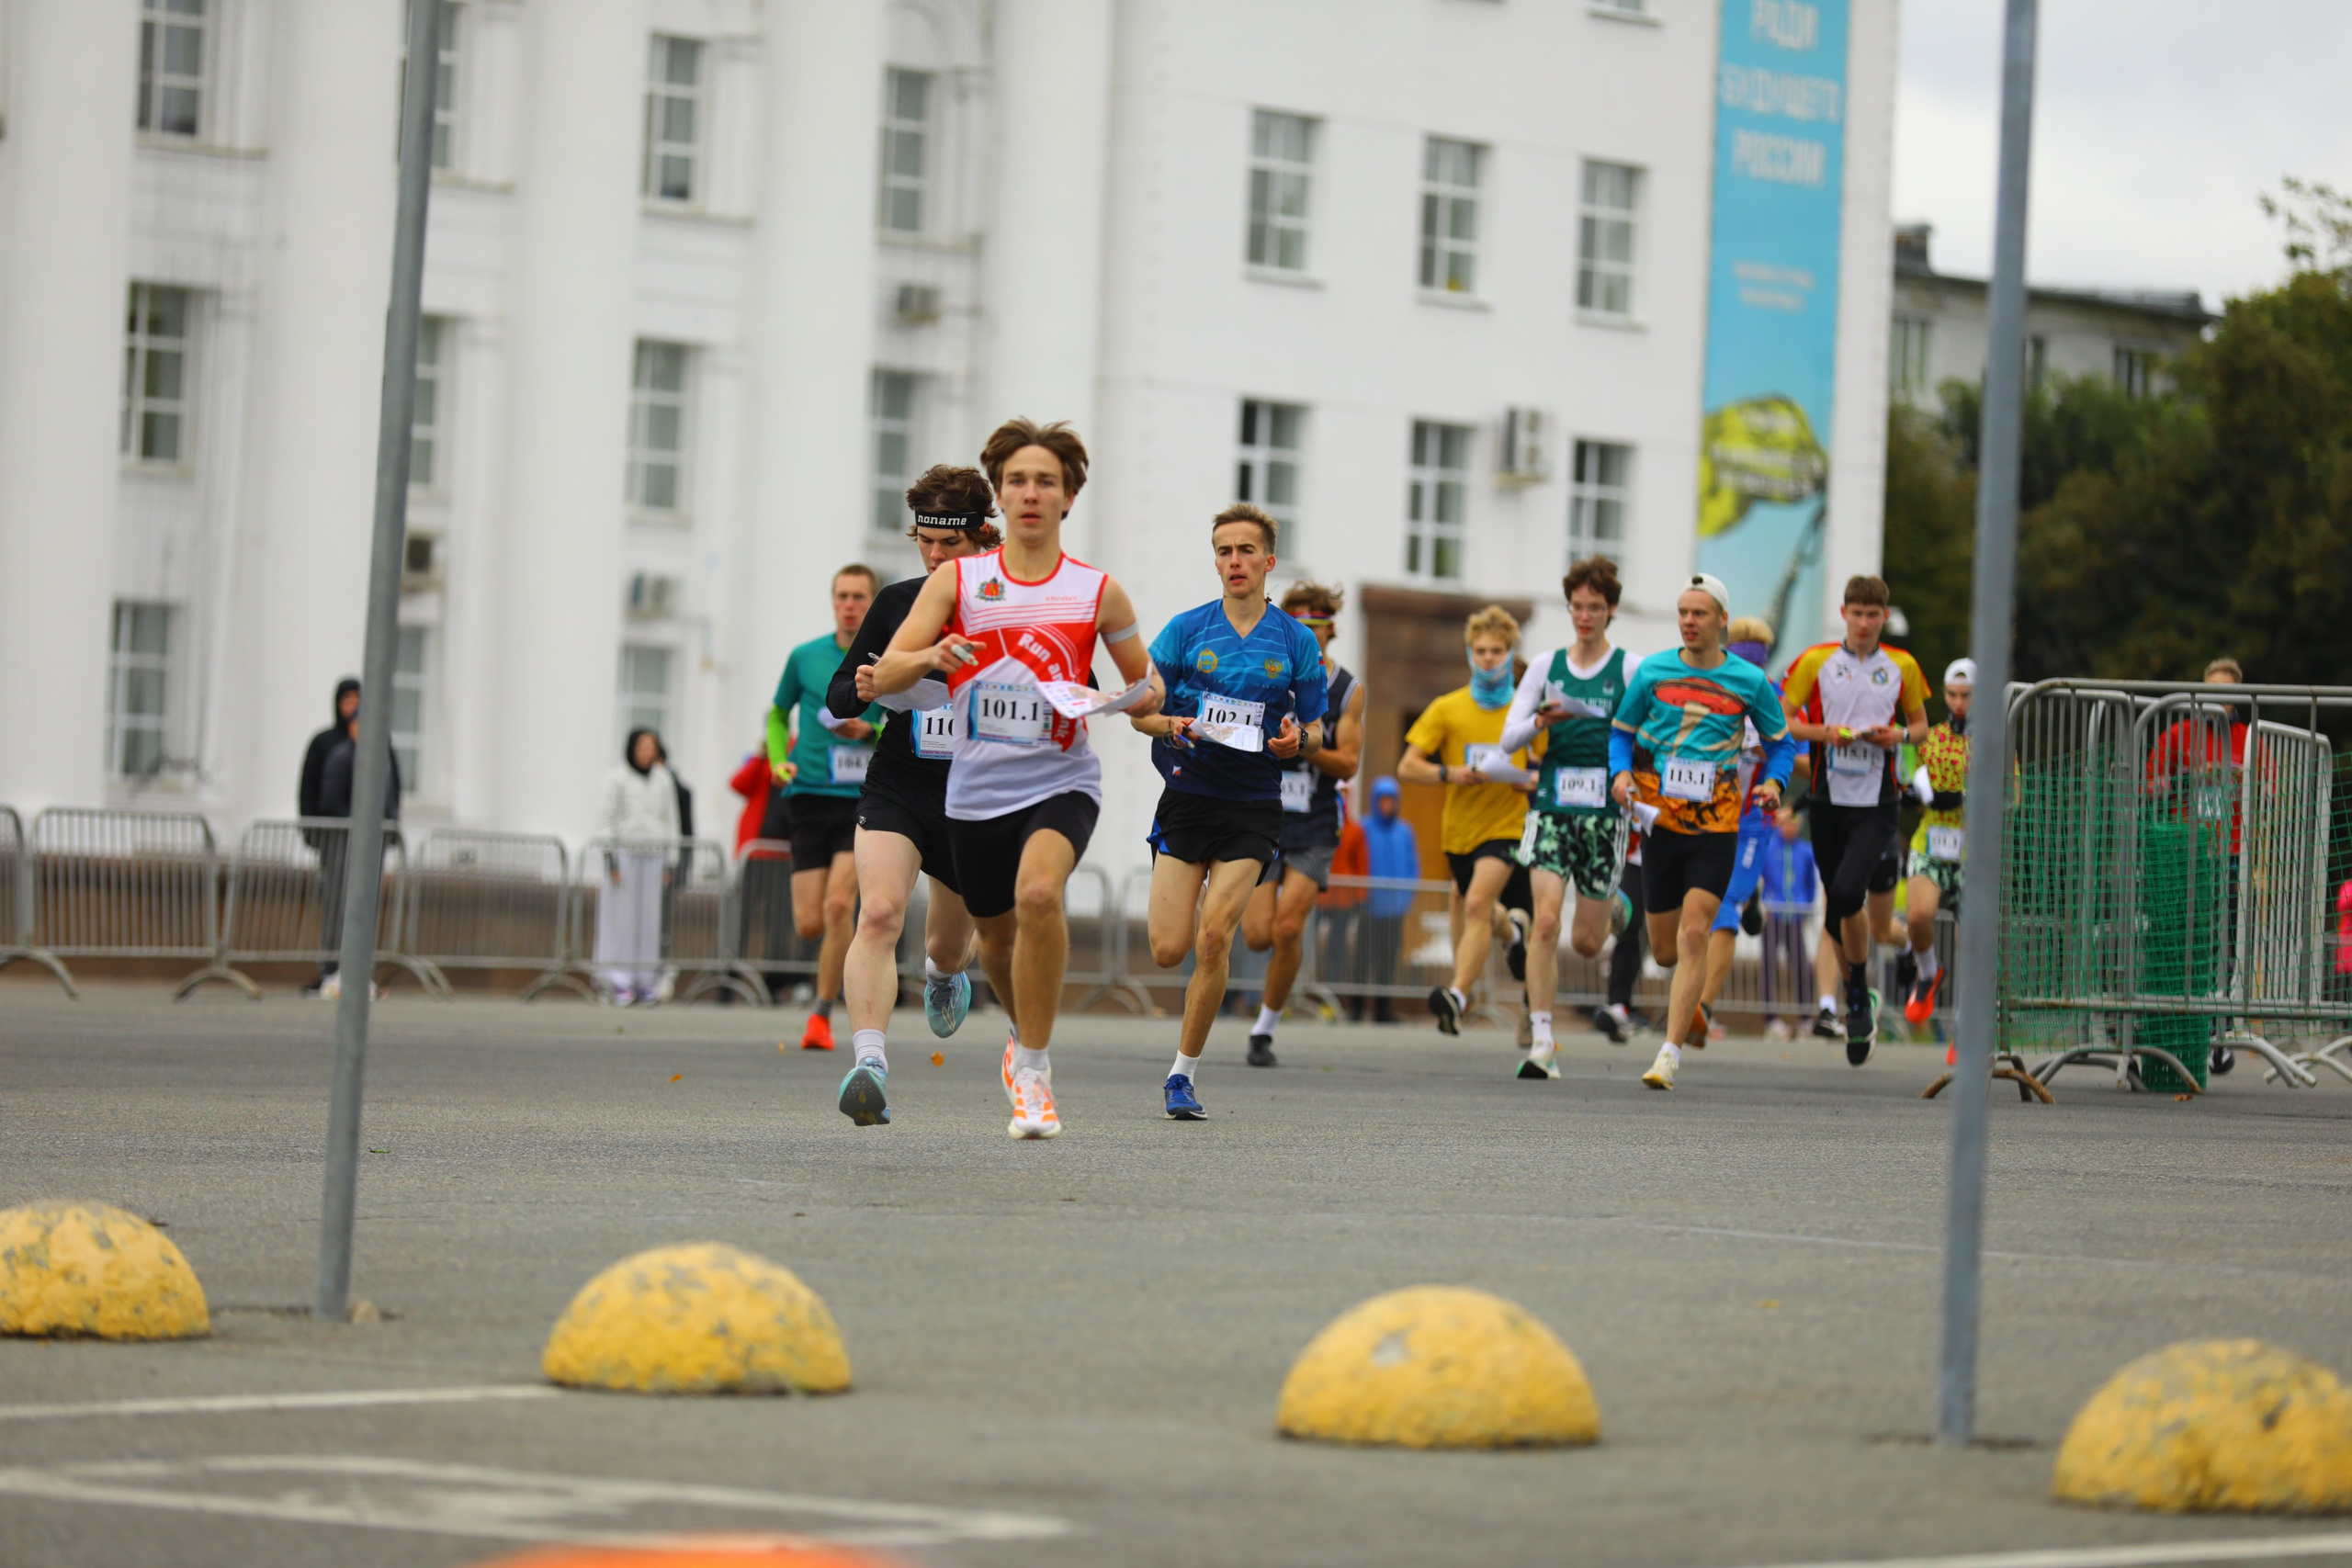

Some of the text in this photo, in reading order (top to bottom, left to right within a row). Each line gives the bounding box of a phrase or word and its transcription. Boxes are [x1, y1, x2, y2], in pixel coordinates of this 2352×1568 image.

[918, 514, 967, 525] noname
[1017, 633, 1063, 682] Run an
[981, 698, 1039, 721] 101.1
[1206, 707, 1251, 726] 1021
[1561, 777, 1596, 792] 109.1
[1669, 768, 1705, 785] 113.1
